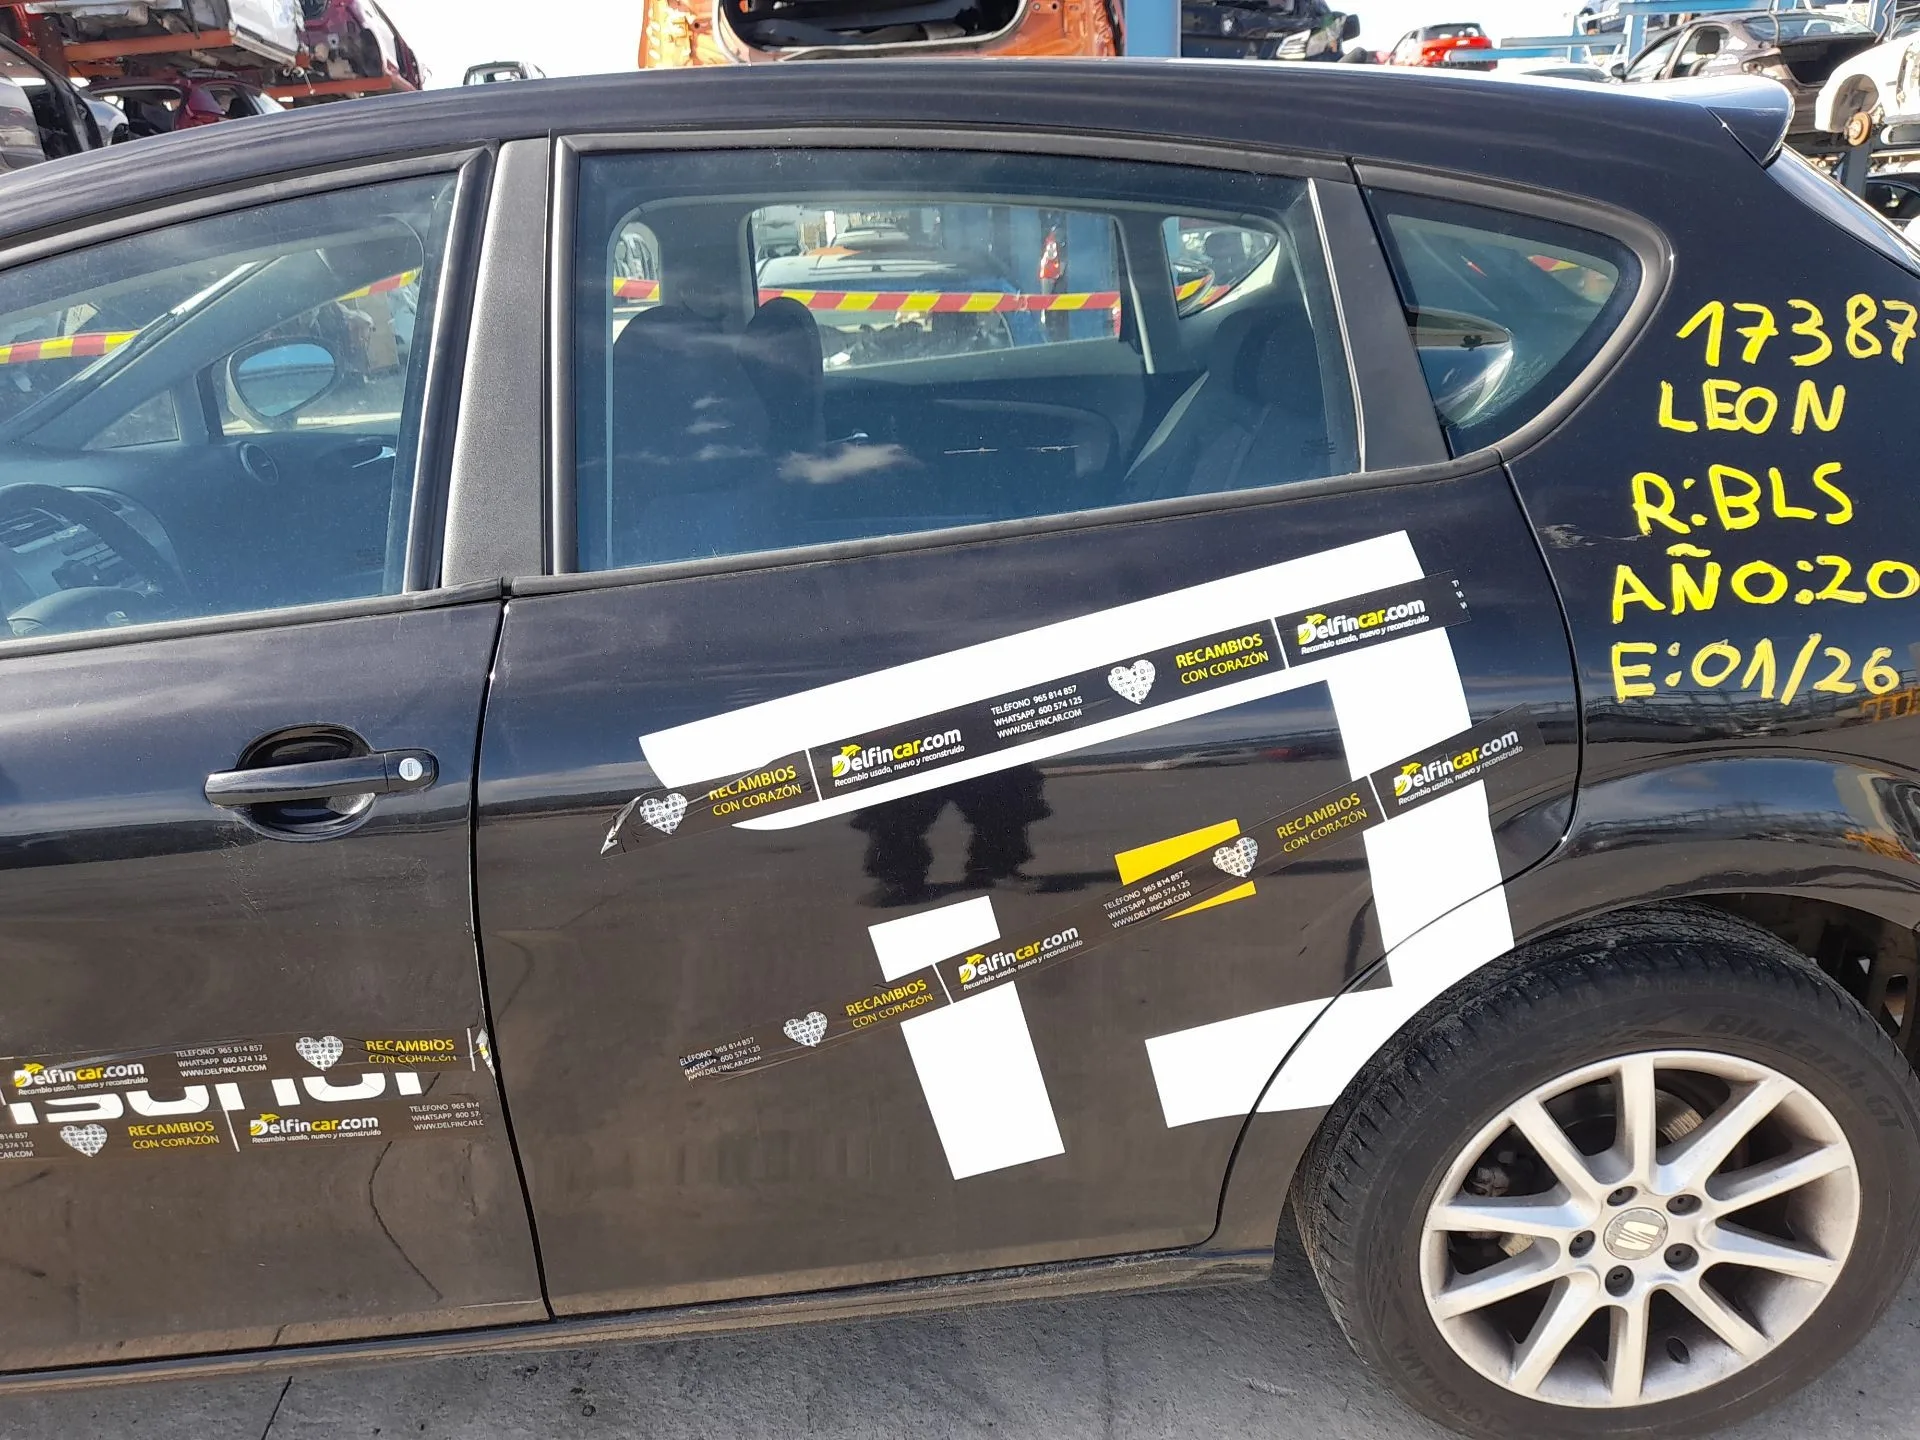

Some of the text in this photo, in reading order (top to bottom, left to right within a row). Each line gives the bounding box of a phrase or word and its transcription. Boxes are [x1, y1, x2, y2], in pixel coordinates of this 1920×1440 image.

[1676, 294, 1917, 367] 17387
[1658, 378, 1846, 434] LEON
[1631, 462, 1853, 536] R:BLS
[1612, 543, 1920, 624] AÑO:20
[1297, 599, 1426, 646] Delfincar.com
[1175, 633, 1263, 669] RECAMBIOS
[1301, 640, 1335, 655] Recambio
[1336, 634, 1359, 646] usado,
[1360, 629, 1380, 640] nuevo
[1181, 650, 1269, 685] CON CORAZÓN
[1612, 633, 1899, 705] E:01/26
[991, 685, 1077, 715] TELÉFONO 965 814 857
[994, 696, 1083, 727] WHATSAPP 600 574 125
[997, 708, 1083, 739] WWW.DELFINCAR.COM
[832, 729, 962, 778] Delfincar.com
[1394, 730, 1519, 797] Delfincar.com
[709, 765, 797, 801] RECAMBIOS
[834, 773, 869, 788] Recambio
[870, 765, 893, 779] usado,
[894, 759, 916, 771] nuevo
[1398, 786, 1431, 806] Recambio
[1432, 777, 1454, 791] usado,
[1455, 767, 1476, 781] nuevo
[712, 783, 802, 816] CON CORAZÓN
[1276, 792, 1361, 839] RECAMBIOS
[1283, 808, 1368, 852] CON CORAZÓN
[1103, 871, 1184, 910] TELÉFONO 965 814 857
[1107, 880, 1191, 920] WHATSAPP 600 574 125
[1112, 890, 1192, 929] WWW.DELFINCAR.COM
[958, 927, 1079, 983] Delfincar.com
[963, 975, 995, 991] Recambio
[996, 966, 1017, 979] usado,
[1018, 957, 1037, 970] nuevo
[845, 979, 927, 1017] RECAMBIOS
[852, 992, 933, 1028] CON CORAZÓN
[218, 1046, 232, 1055] 965
[233, 1045, 248, 1053] 814
[249, 1044, 263, 1052] 857
[366, 1039, 454, 1052] RECAMBIOS
[368, 1054, 395, 1064] CON
[720, 1053, 733, 1063] 600
[734, 1049, 748, 1058] 574
[748, 1044, 761, 1054] 125
[728, 1040, 742, 1050] 814
[742, 1036, 754, 1046] 857
[14, 1063, 145, 1088] Delfincar.com
[177, 1054, 268, 1067] WHATSAPP 600 574 125
[180, 1064, 267, 1077] WWW.DELFINCAR.COM
[18, 1086, 52, 1096] Recambio
[53, 1084, 77, 1093] usado,
[78, 1082, 99, 1090] nuevo
[128, 1120, 215, 1137] RECAMBIOS
[250, 1117, 378, 1136] Delfincar.com
[411, 1110, 481, 1122] WHATSAPP 600 57
[132, 1133, 220, 1150] CON CORAZÓN
[252, 1136, 286, 1144] Recambio
[311, 1132, 332, 1140] nuevo
